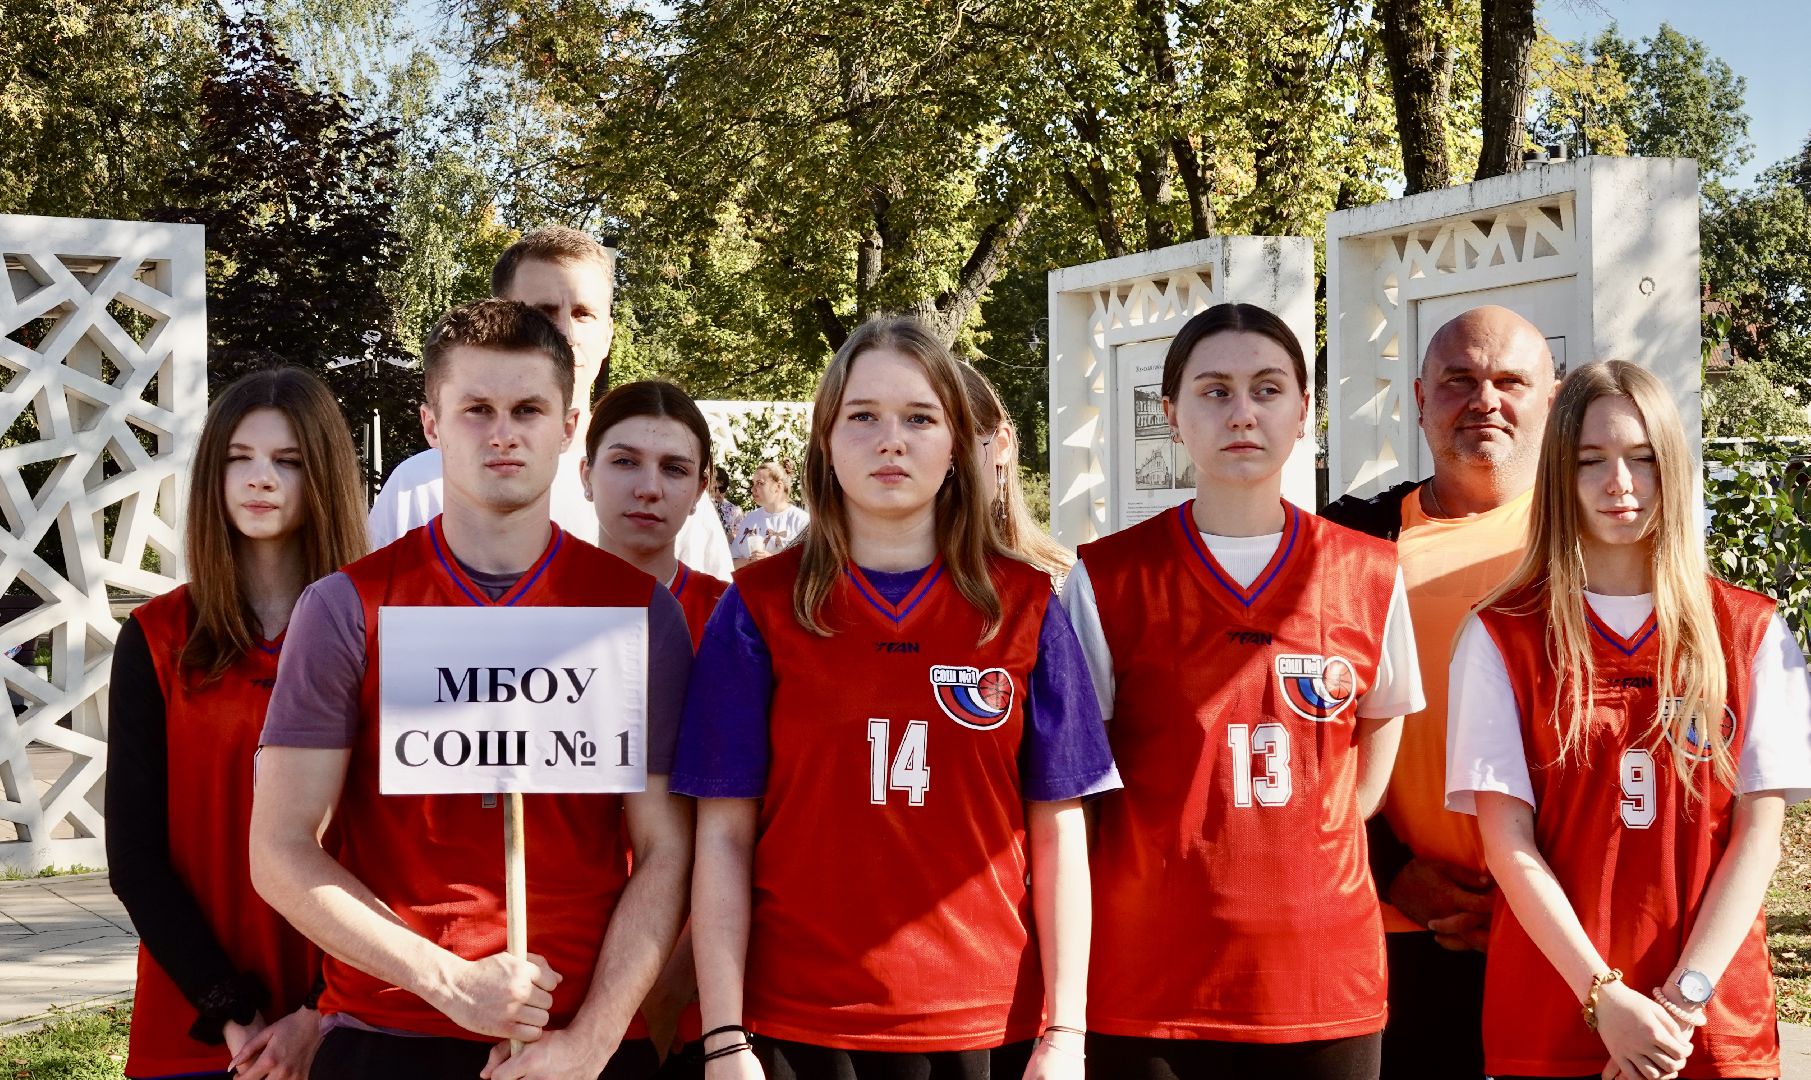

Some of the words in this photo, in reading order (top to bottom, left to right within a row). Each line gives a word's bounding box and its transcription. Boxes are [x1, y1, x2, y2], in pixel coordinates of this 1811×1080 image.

[434, 667, 599, 704] МБОУ
[933, 668, 957, 683] СОШ
[958, 669, 978, 684] №1
[395, 730, 529, 767] СОШ
[544, 730, 597, 767] №
[615, 730, 635, 767] 1
[867, 718, 931, 806] 14
[1227, 722, 1293, 807] 13
[1620, 748, 1657, 829] 9
